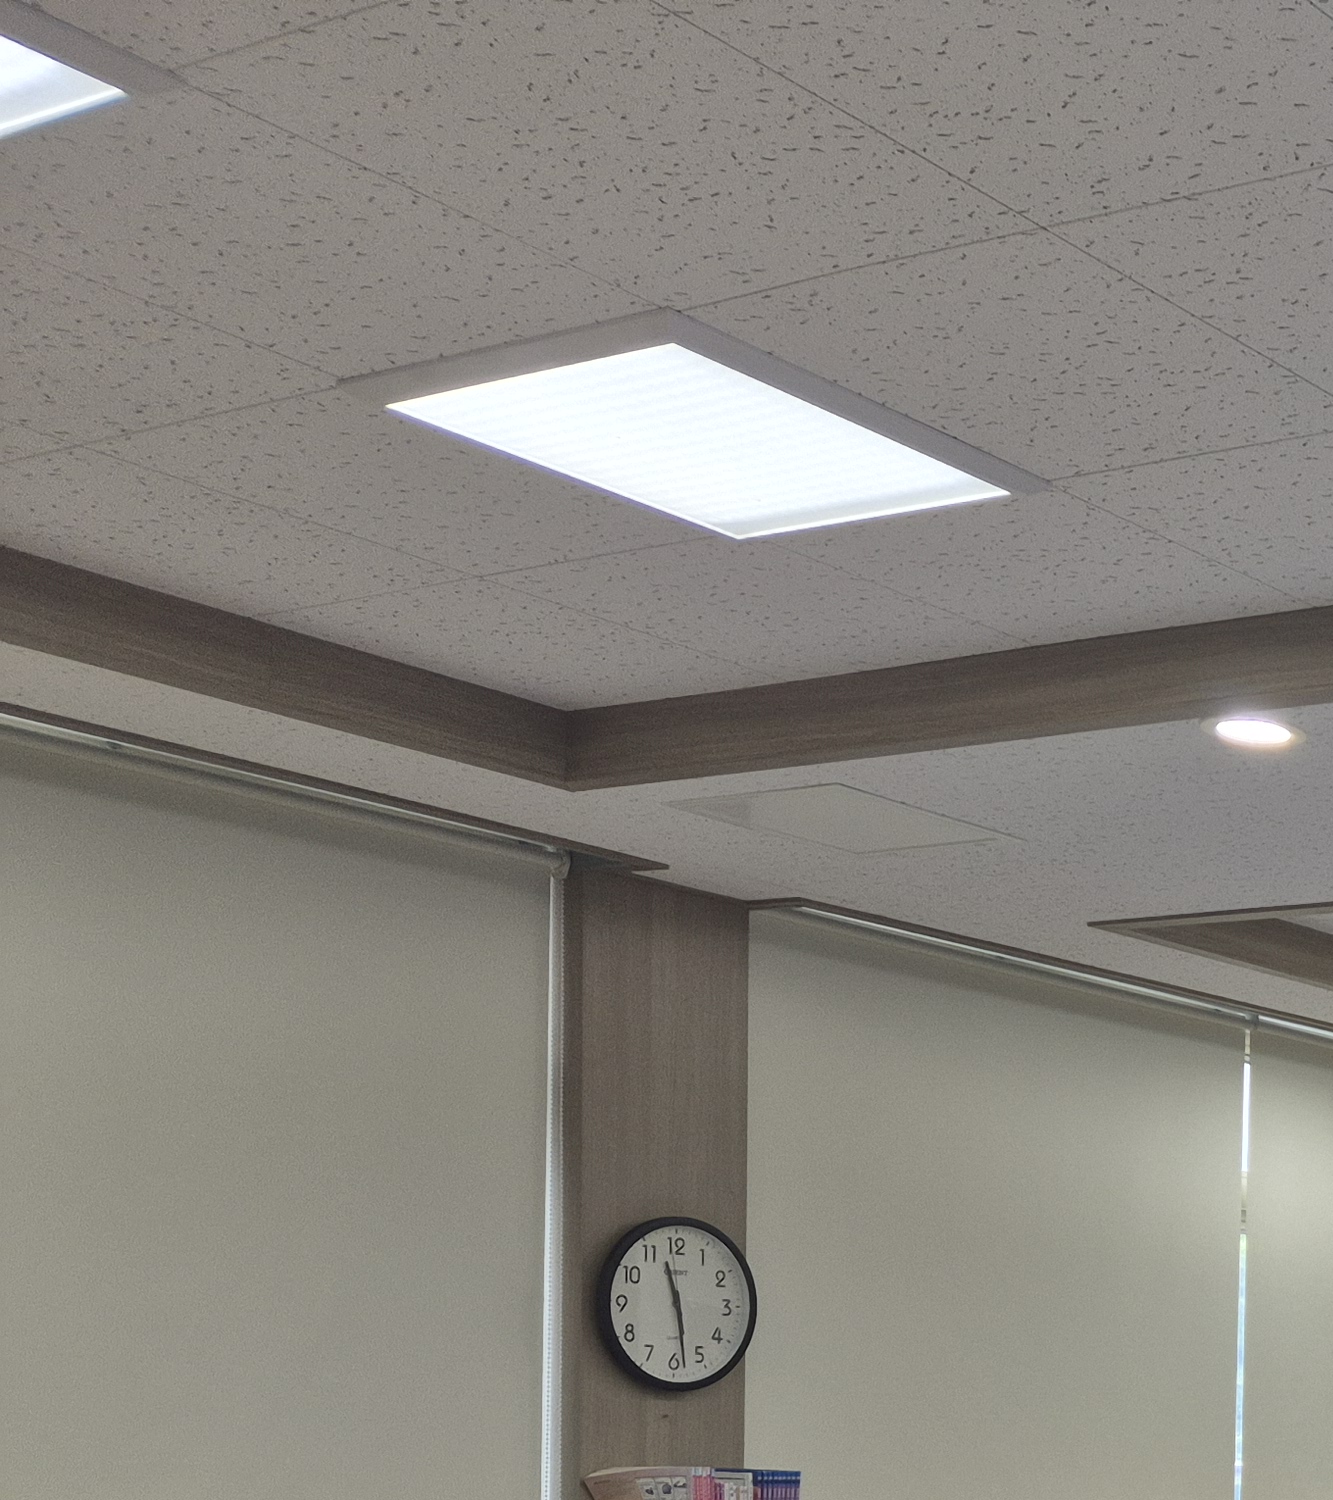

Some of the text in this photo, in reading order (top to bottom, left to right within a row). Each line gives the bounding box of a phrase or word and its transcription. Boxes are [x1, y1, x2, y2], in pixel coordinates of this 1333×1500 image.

[642, 1244, 657, 1263] 11
[667, 1237, 686, 1256] 12
[699, 1249, 705, 1266] 1
[623, 1265, 641, 1284] 10
[715, 1270, 726, 1288] 2
[615, 1294, 628, 1312] 9
[721, 1299, 732, 1316] 3
[624, 1323, 635, 1342] 8
[711, 1327, 723, 1344] 4
[644, 1345, 654, 1362] 7
[668, 1352, 680, 1371] 6
[695, 1346, 705, 1363] 5
